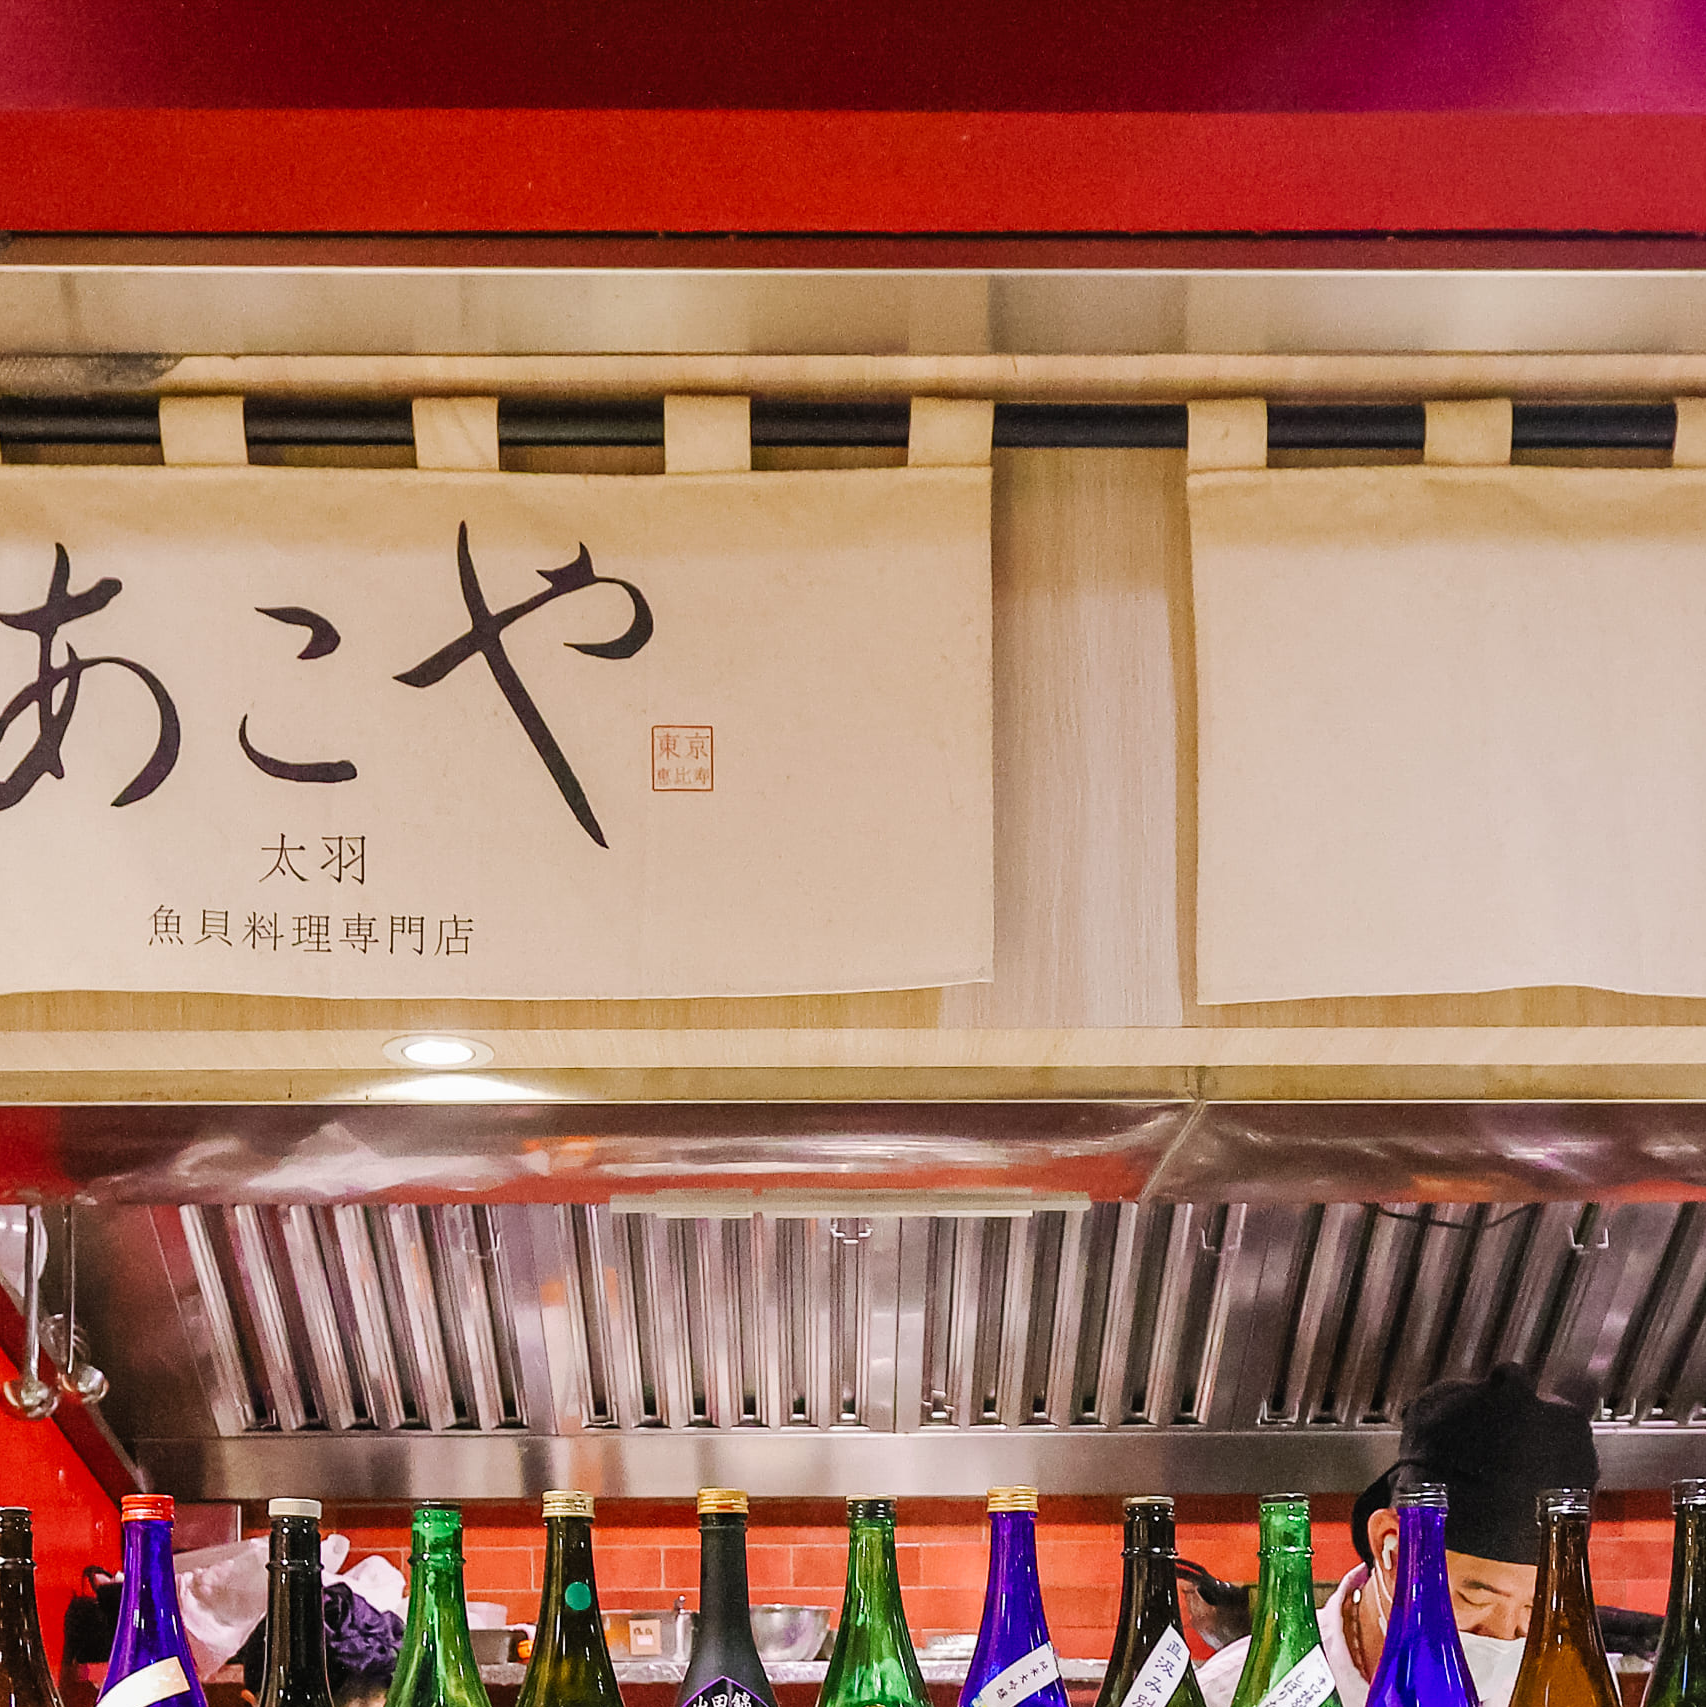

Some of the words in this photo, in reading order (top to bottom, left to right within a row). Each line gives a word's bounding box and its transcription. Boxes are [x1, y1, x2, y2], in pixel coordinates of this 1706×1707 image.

[656, 732, 710, 760] 東京
[260, 833, 368, 885] 太羽
[145, 904, 478, 959] 魚貝料理専門店
